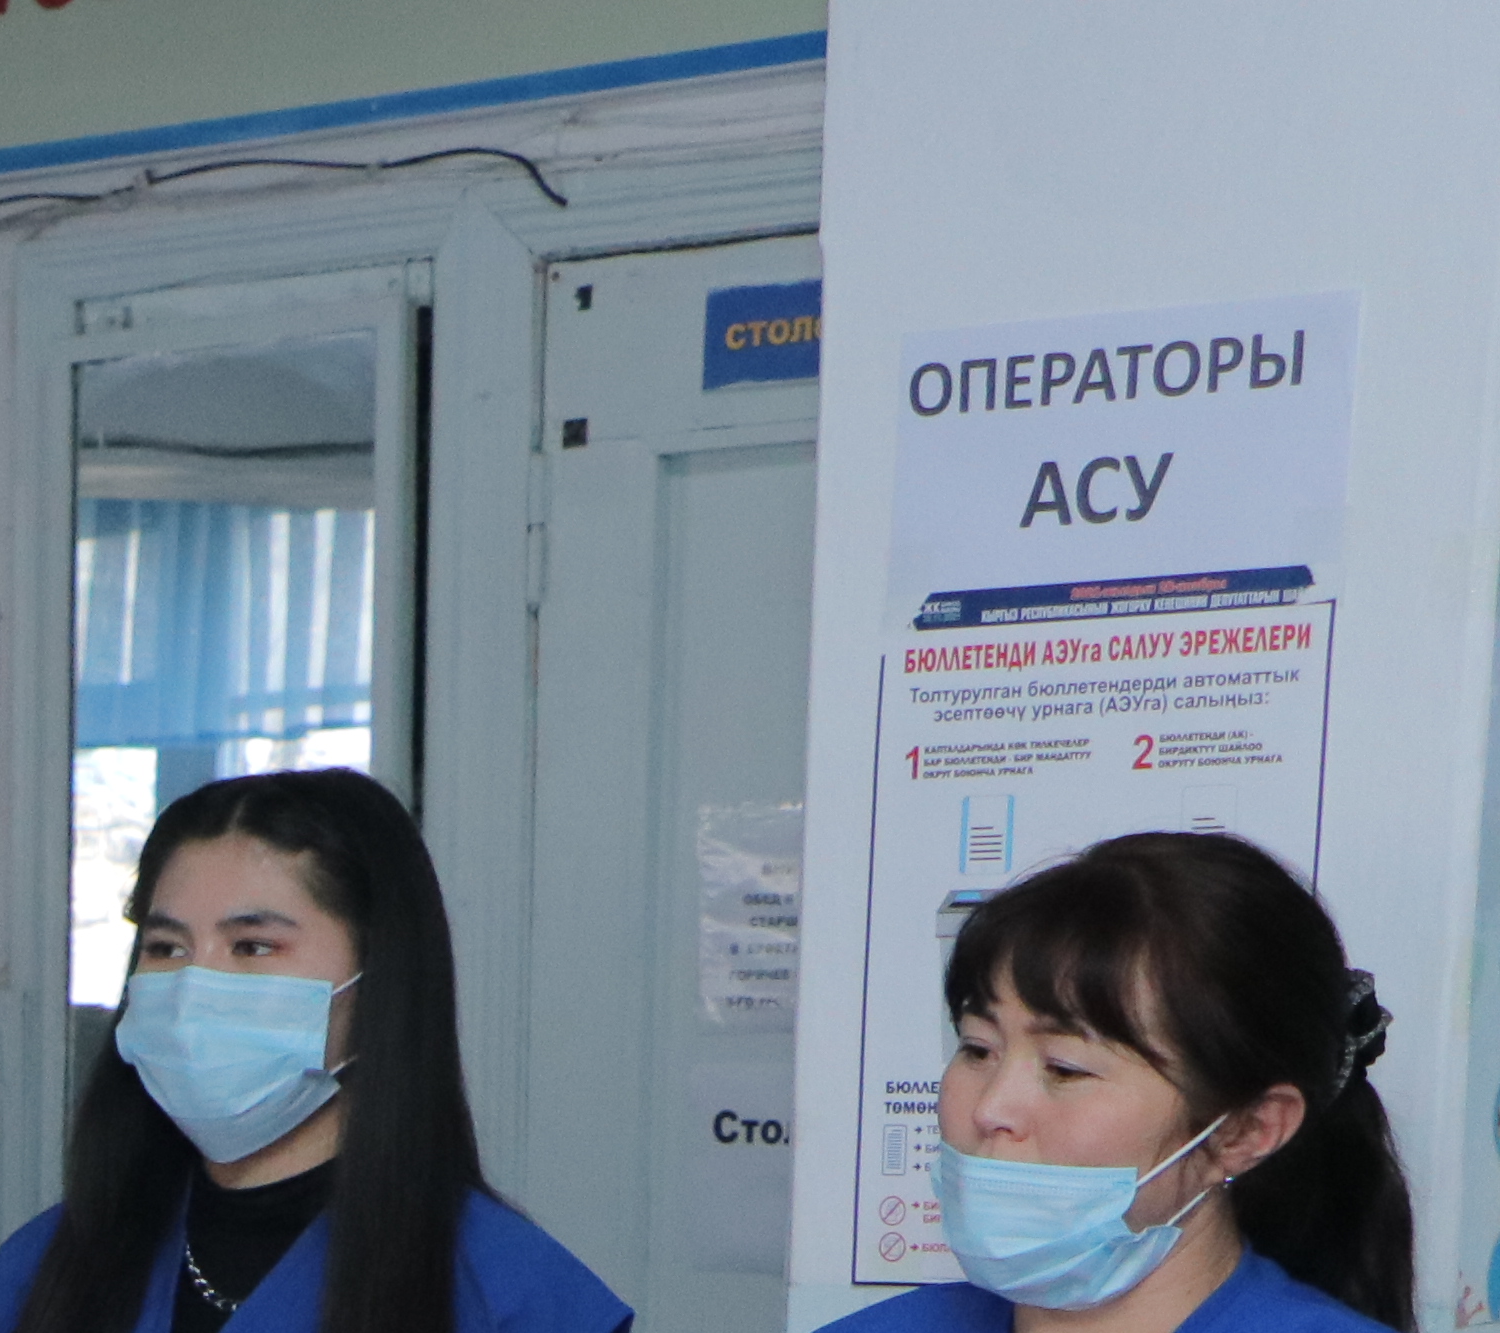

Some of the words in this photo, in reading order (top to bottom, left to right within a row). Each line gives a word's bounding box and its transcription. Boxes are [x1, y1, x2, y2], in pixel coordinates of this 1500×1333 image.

[908, 330, 1306, 417] ОПЕРАТОРЫ
[1019, 452, 1174, 528] АСУ
[904, 641, 1036, 673] БЮЛЛЕТЕНДИ
[1042, 638, 1101, 666] АЭУга
[1108, 631, 1175, 661] САЛУУ
[1179, 623, 1312, 657] ЭРЕЖЕЛЕРИ
[910, 684, 1021, 706] Толтурулган
[1028, 676, 1177, 698] бюллетендерди
[1183, 669, 1300, 689] автоматтык
[1032, 701, 1093, 721] урнага
[1099, 694, 1168, 717] (АЭУга)
[905, 746, 920, 780] 1
[1132, 734, 1155, 770] 2
[886, 1081, 940, 1095] БЮЛЛЕ
[884, 1101, 938, 1115] ТӨМӨН
[926, 1125, 940, 1135] ТЕ
